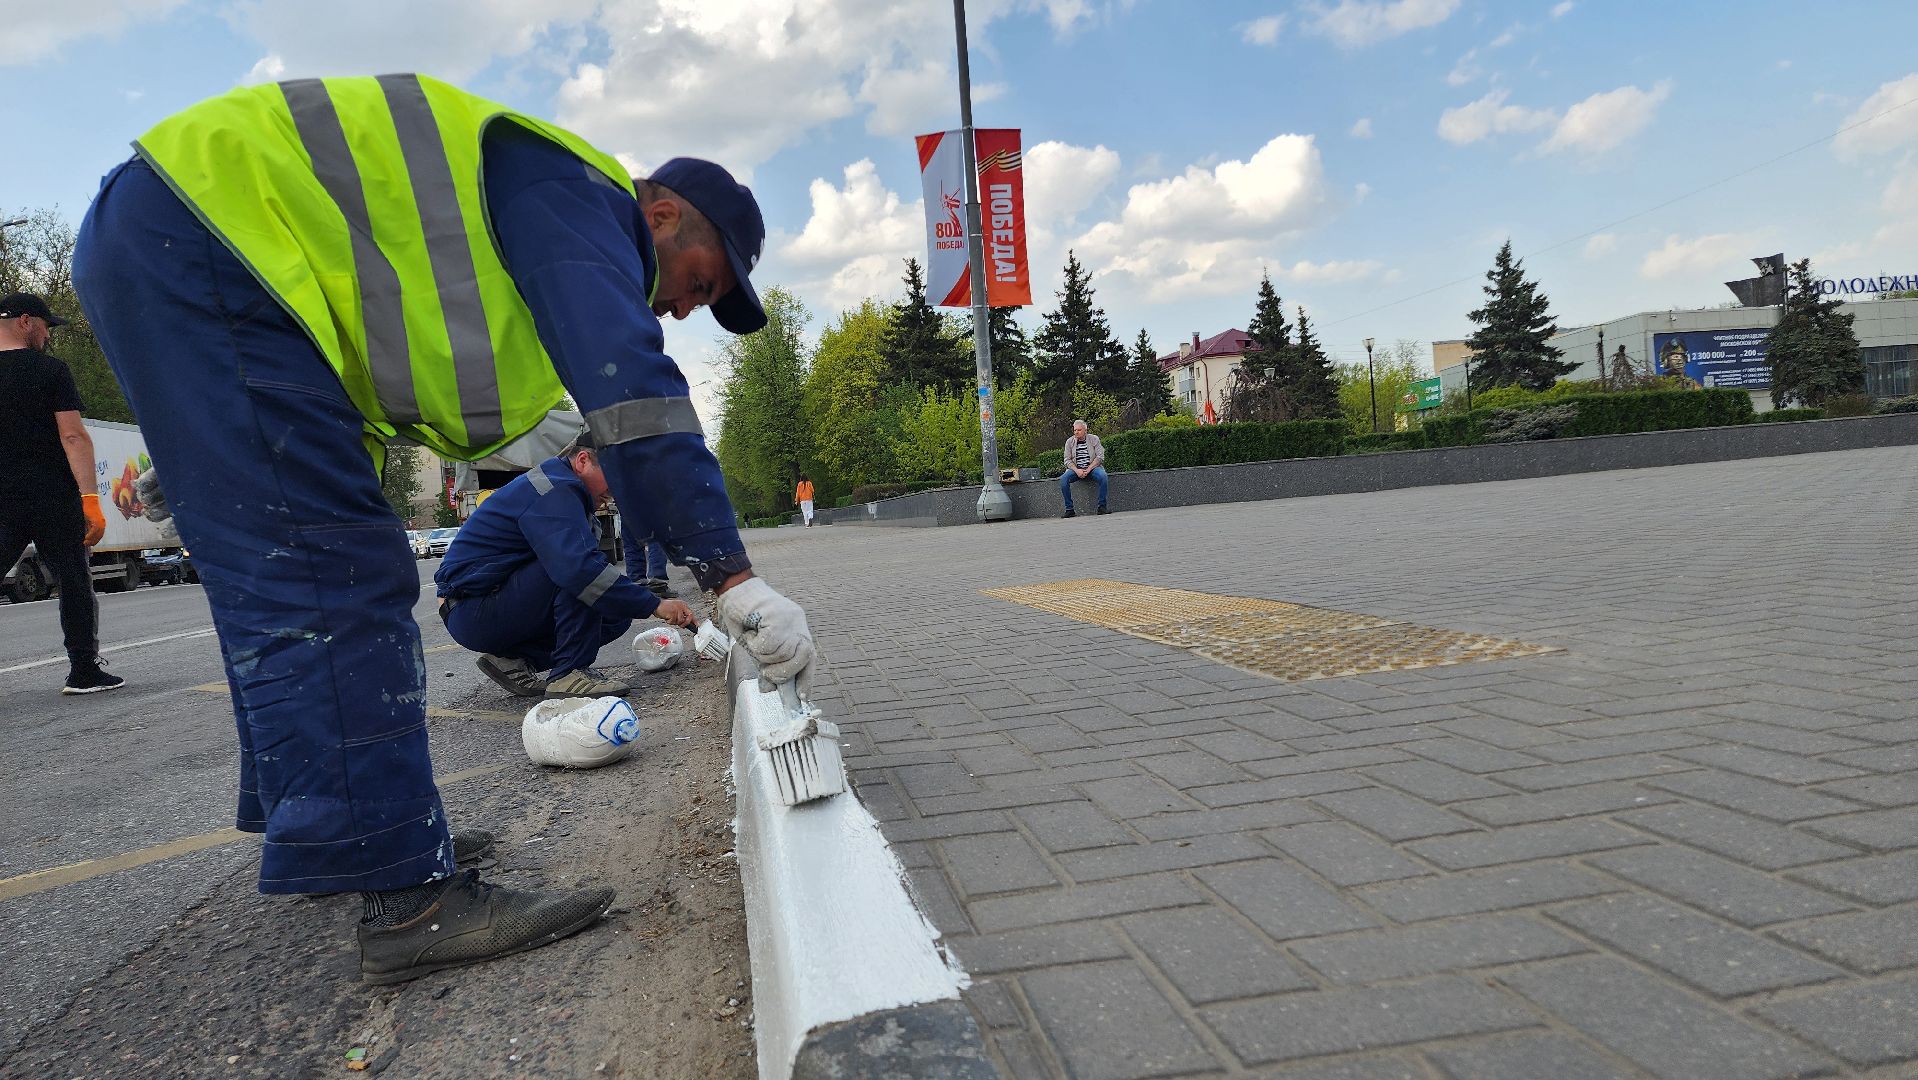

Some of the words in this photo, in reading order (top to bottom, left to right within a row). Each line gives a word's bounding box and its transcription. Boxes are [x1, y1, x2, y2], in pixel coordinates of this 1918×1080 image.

[936, 222, 952, 238] 80
[989, 183, 1017, 282] ПОБЕДА!
[1743, 349, 1757, 357] 200
